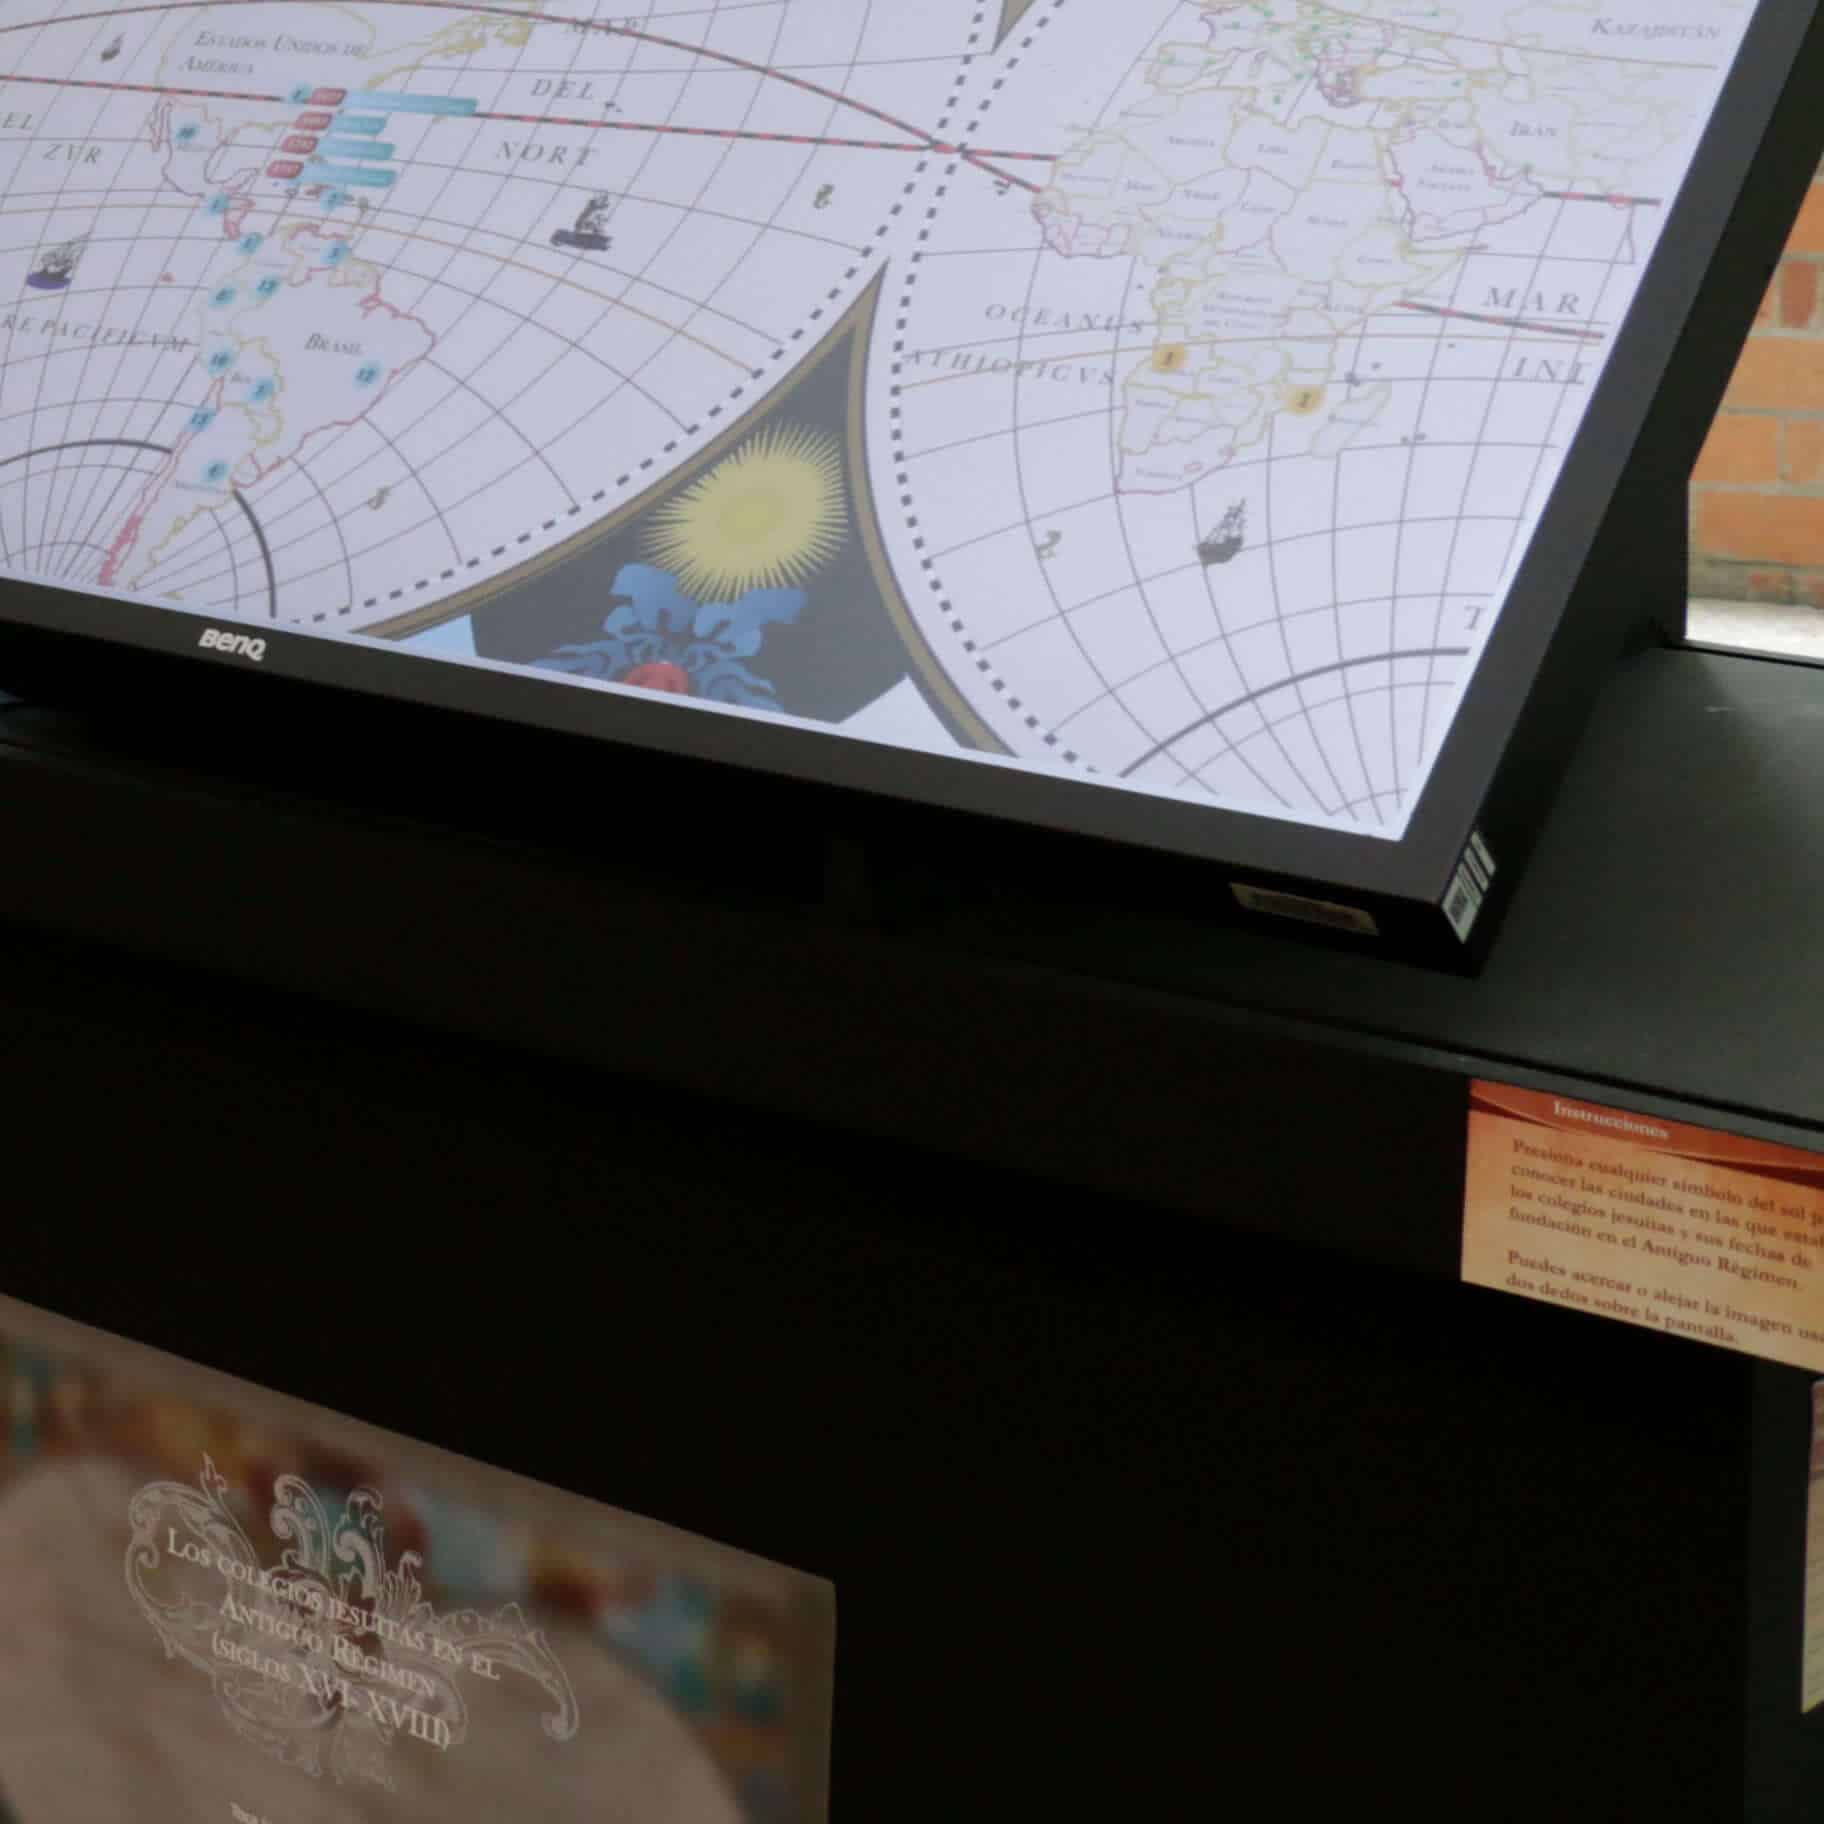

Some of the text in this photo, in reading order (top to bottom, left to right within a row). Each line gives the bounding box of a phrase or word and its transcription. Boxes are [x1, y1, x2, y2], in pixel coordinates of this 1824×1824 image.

[530, 78, 595, 100] DEL
[1481, 287, 1580, 314] MAR
[197, 628, 267, 662] BenQ
[1553, 1100, 1669, 1140] Instrucciones
[1511, 1165, 1577, 1188] conocer
[1581, 1176, 1603, 1193] las
[1608, 1186, 1683, 1214] ciudades
[1689, 1207, 1710, 1222] en
[1716, 1209, 1739, 1228] las
[1745, 1220, 1777, 1238] que
[1512, 1137, 1584, 1168] Presiona
[1588, 1162, 1667, 1187] cualquier
[1747, 1195, 1775, 1212] del
[1781, 1206, 1805, 1221] sol
[1511, 1183, 1532, 1200] los
[1538, 1194, 1606, 1217] colegios
[1612, 1207, 1674, 1234] jesuitas
[1696, 1231, 1723, 1247] sus
[1729, 1237, 1785, 1262] fechas
[1792, 1250, 1812, 1268] de
[1596, 1231, 1617, 1245] en
[1622, 1234, 1636, 1248] el
[1641, 1239, 1712, 1268] Antiguo
[1506, 1272, 1739, 1344] dos dedos sobre la pantalla.
[1508, 1249, 1567, 1277] Puedes
[1572, 1271, 1632, 1293] acercar
[1654, 1288, 1698, 1309] alejar
[1705, 1298, 1720, 1315] la
[1725, 1305, 1793, 1333] imagen
[168, 1526, 210, 1567] LOS
[433, 1637, 463, 1665] EN
[470, 1651, 501, 1680] EL
